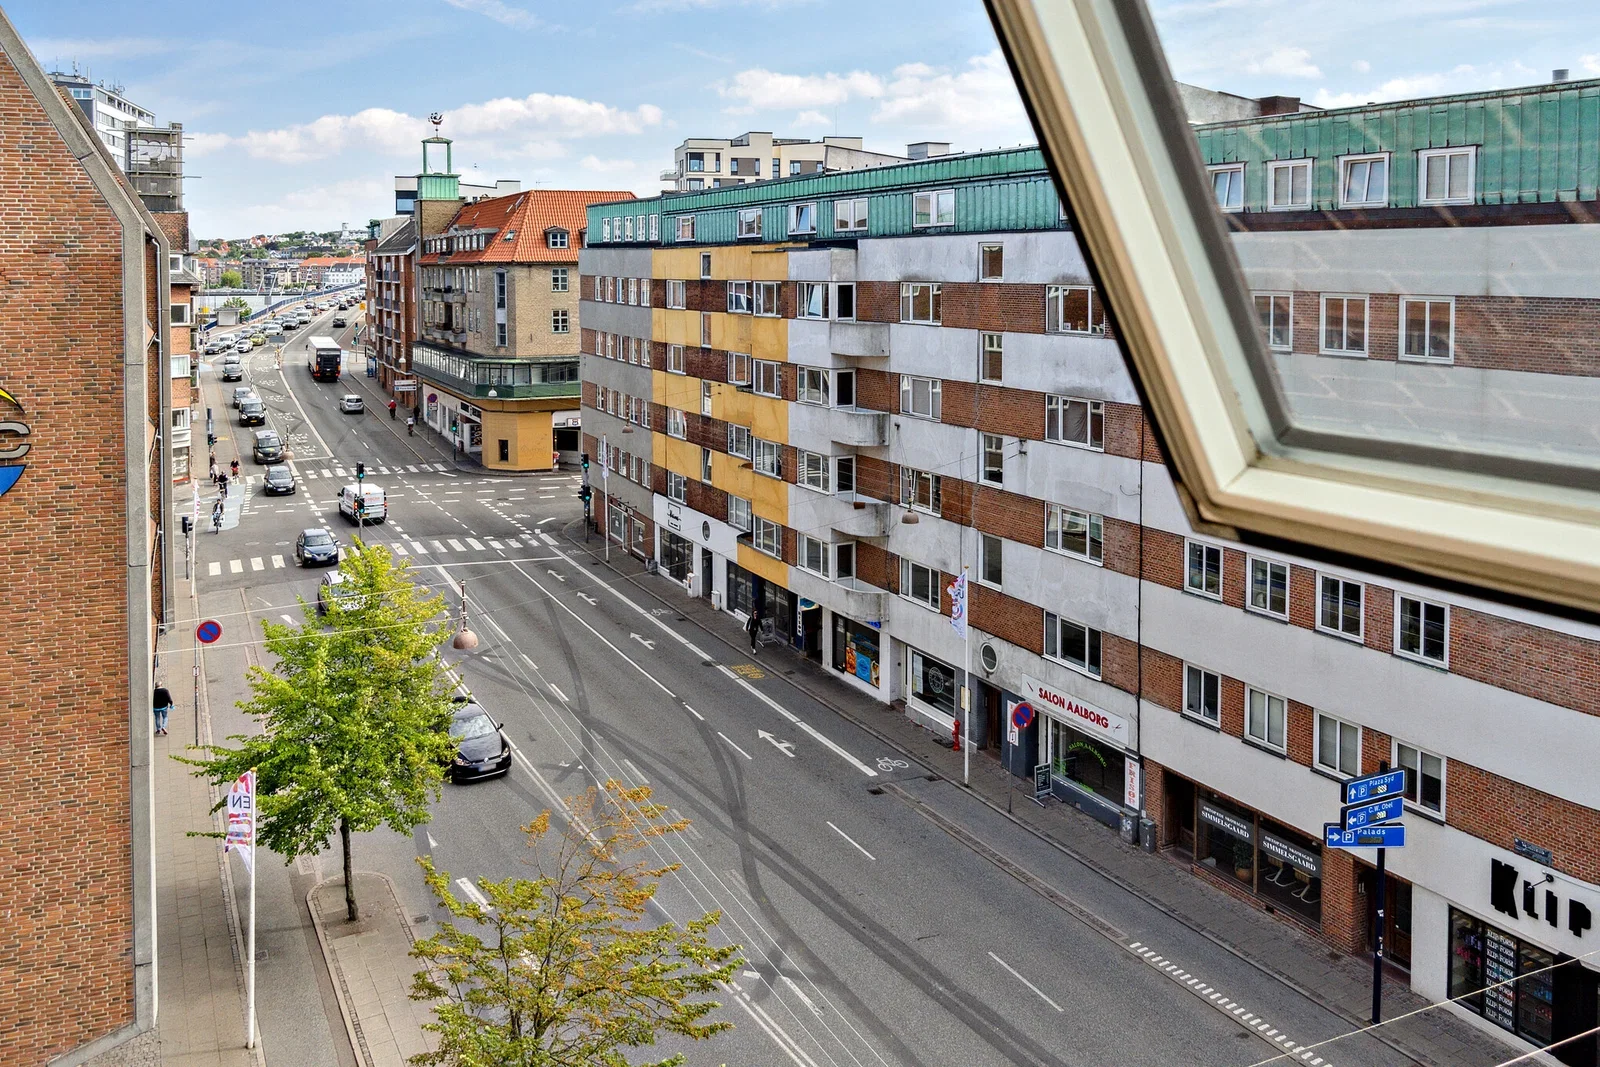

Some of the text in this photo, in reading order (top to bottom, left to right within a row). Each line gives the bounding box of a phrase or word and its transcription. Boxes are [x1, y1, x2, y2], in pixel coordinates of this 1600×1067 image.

[1038, 687, 1109, 729] SALON AALBORG
[1384, 775, 1394, 783] Syd
[1201, 810, 1250, 839] SIMMELSGAARD
[1262, 840, 1317, 872] SIMMELSGAARD
